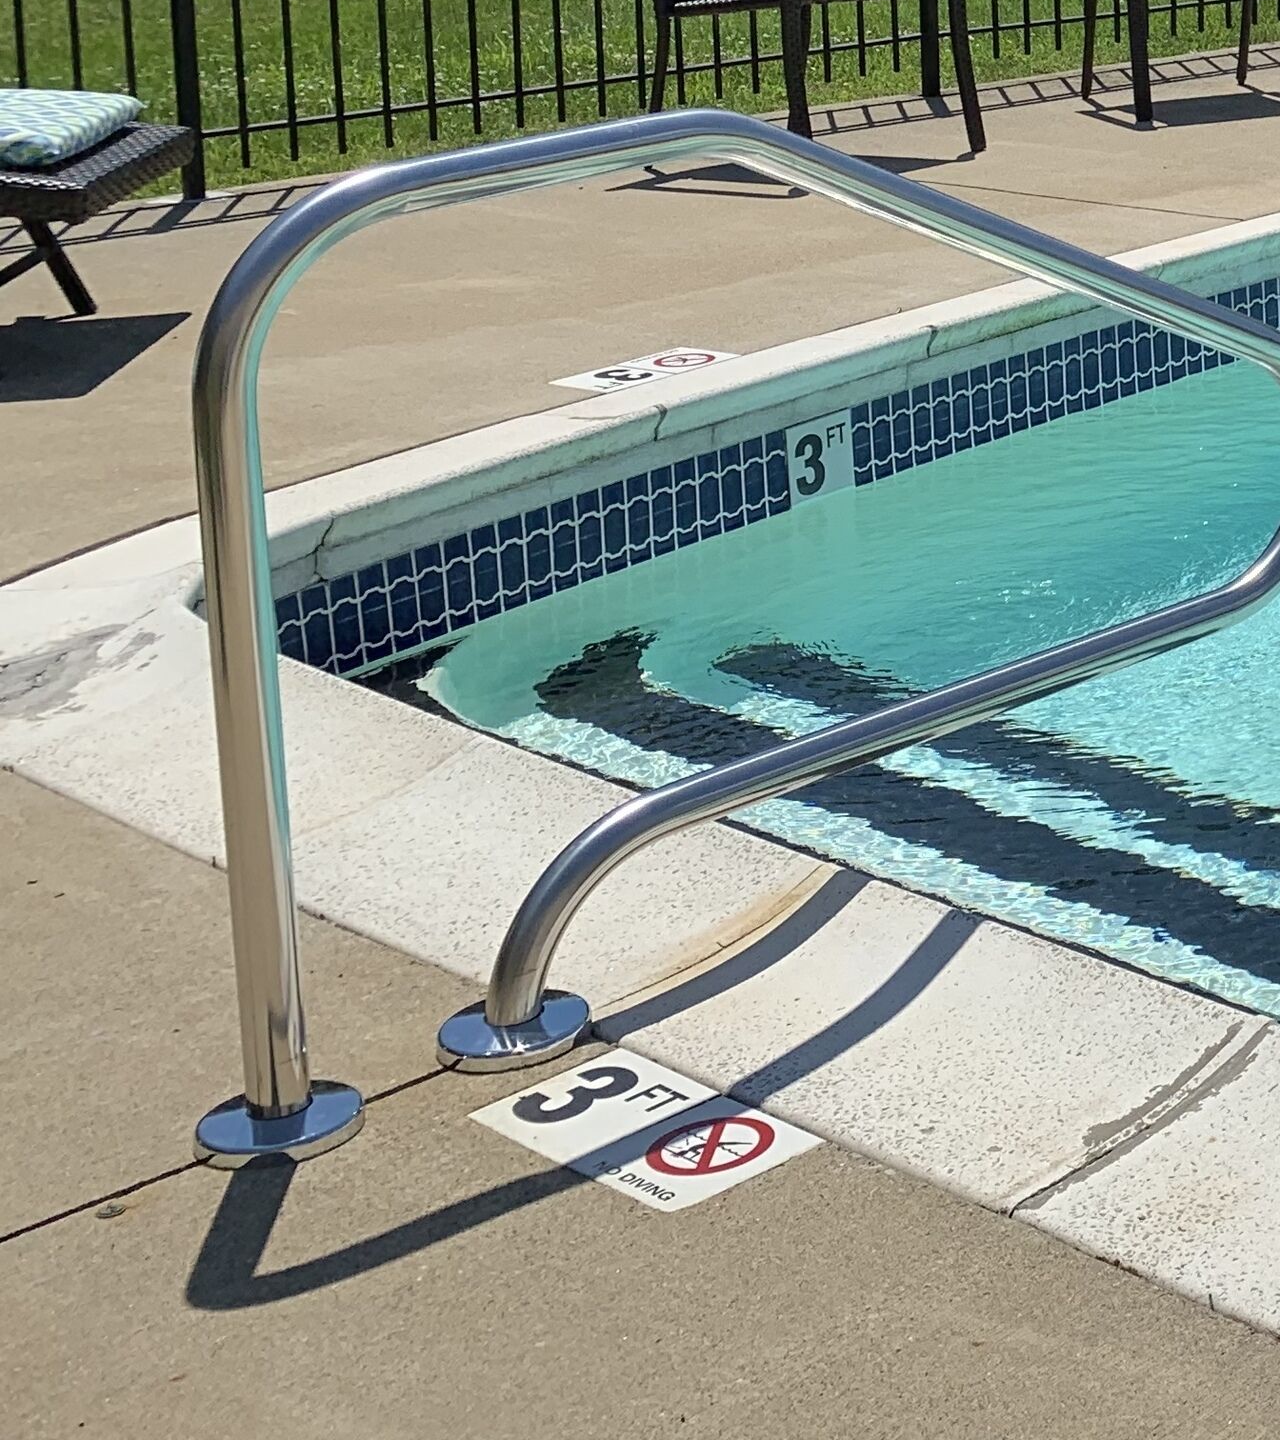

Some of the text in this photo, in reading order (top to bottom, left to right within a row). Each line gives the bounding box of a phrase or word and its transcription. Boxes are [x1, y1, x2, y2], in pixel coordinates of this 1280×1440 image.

[594, 369, 653, 381] 3
[795, 422, 846, 495] 3 FT
[512, 1066, 690, 1123] 3 FT
[596, 1162, 676, 1202] NO DIVING
